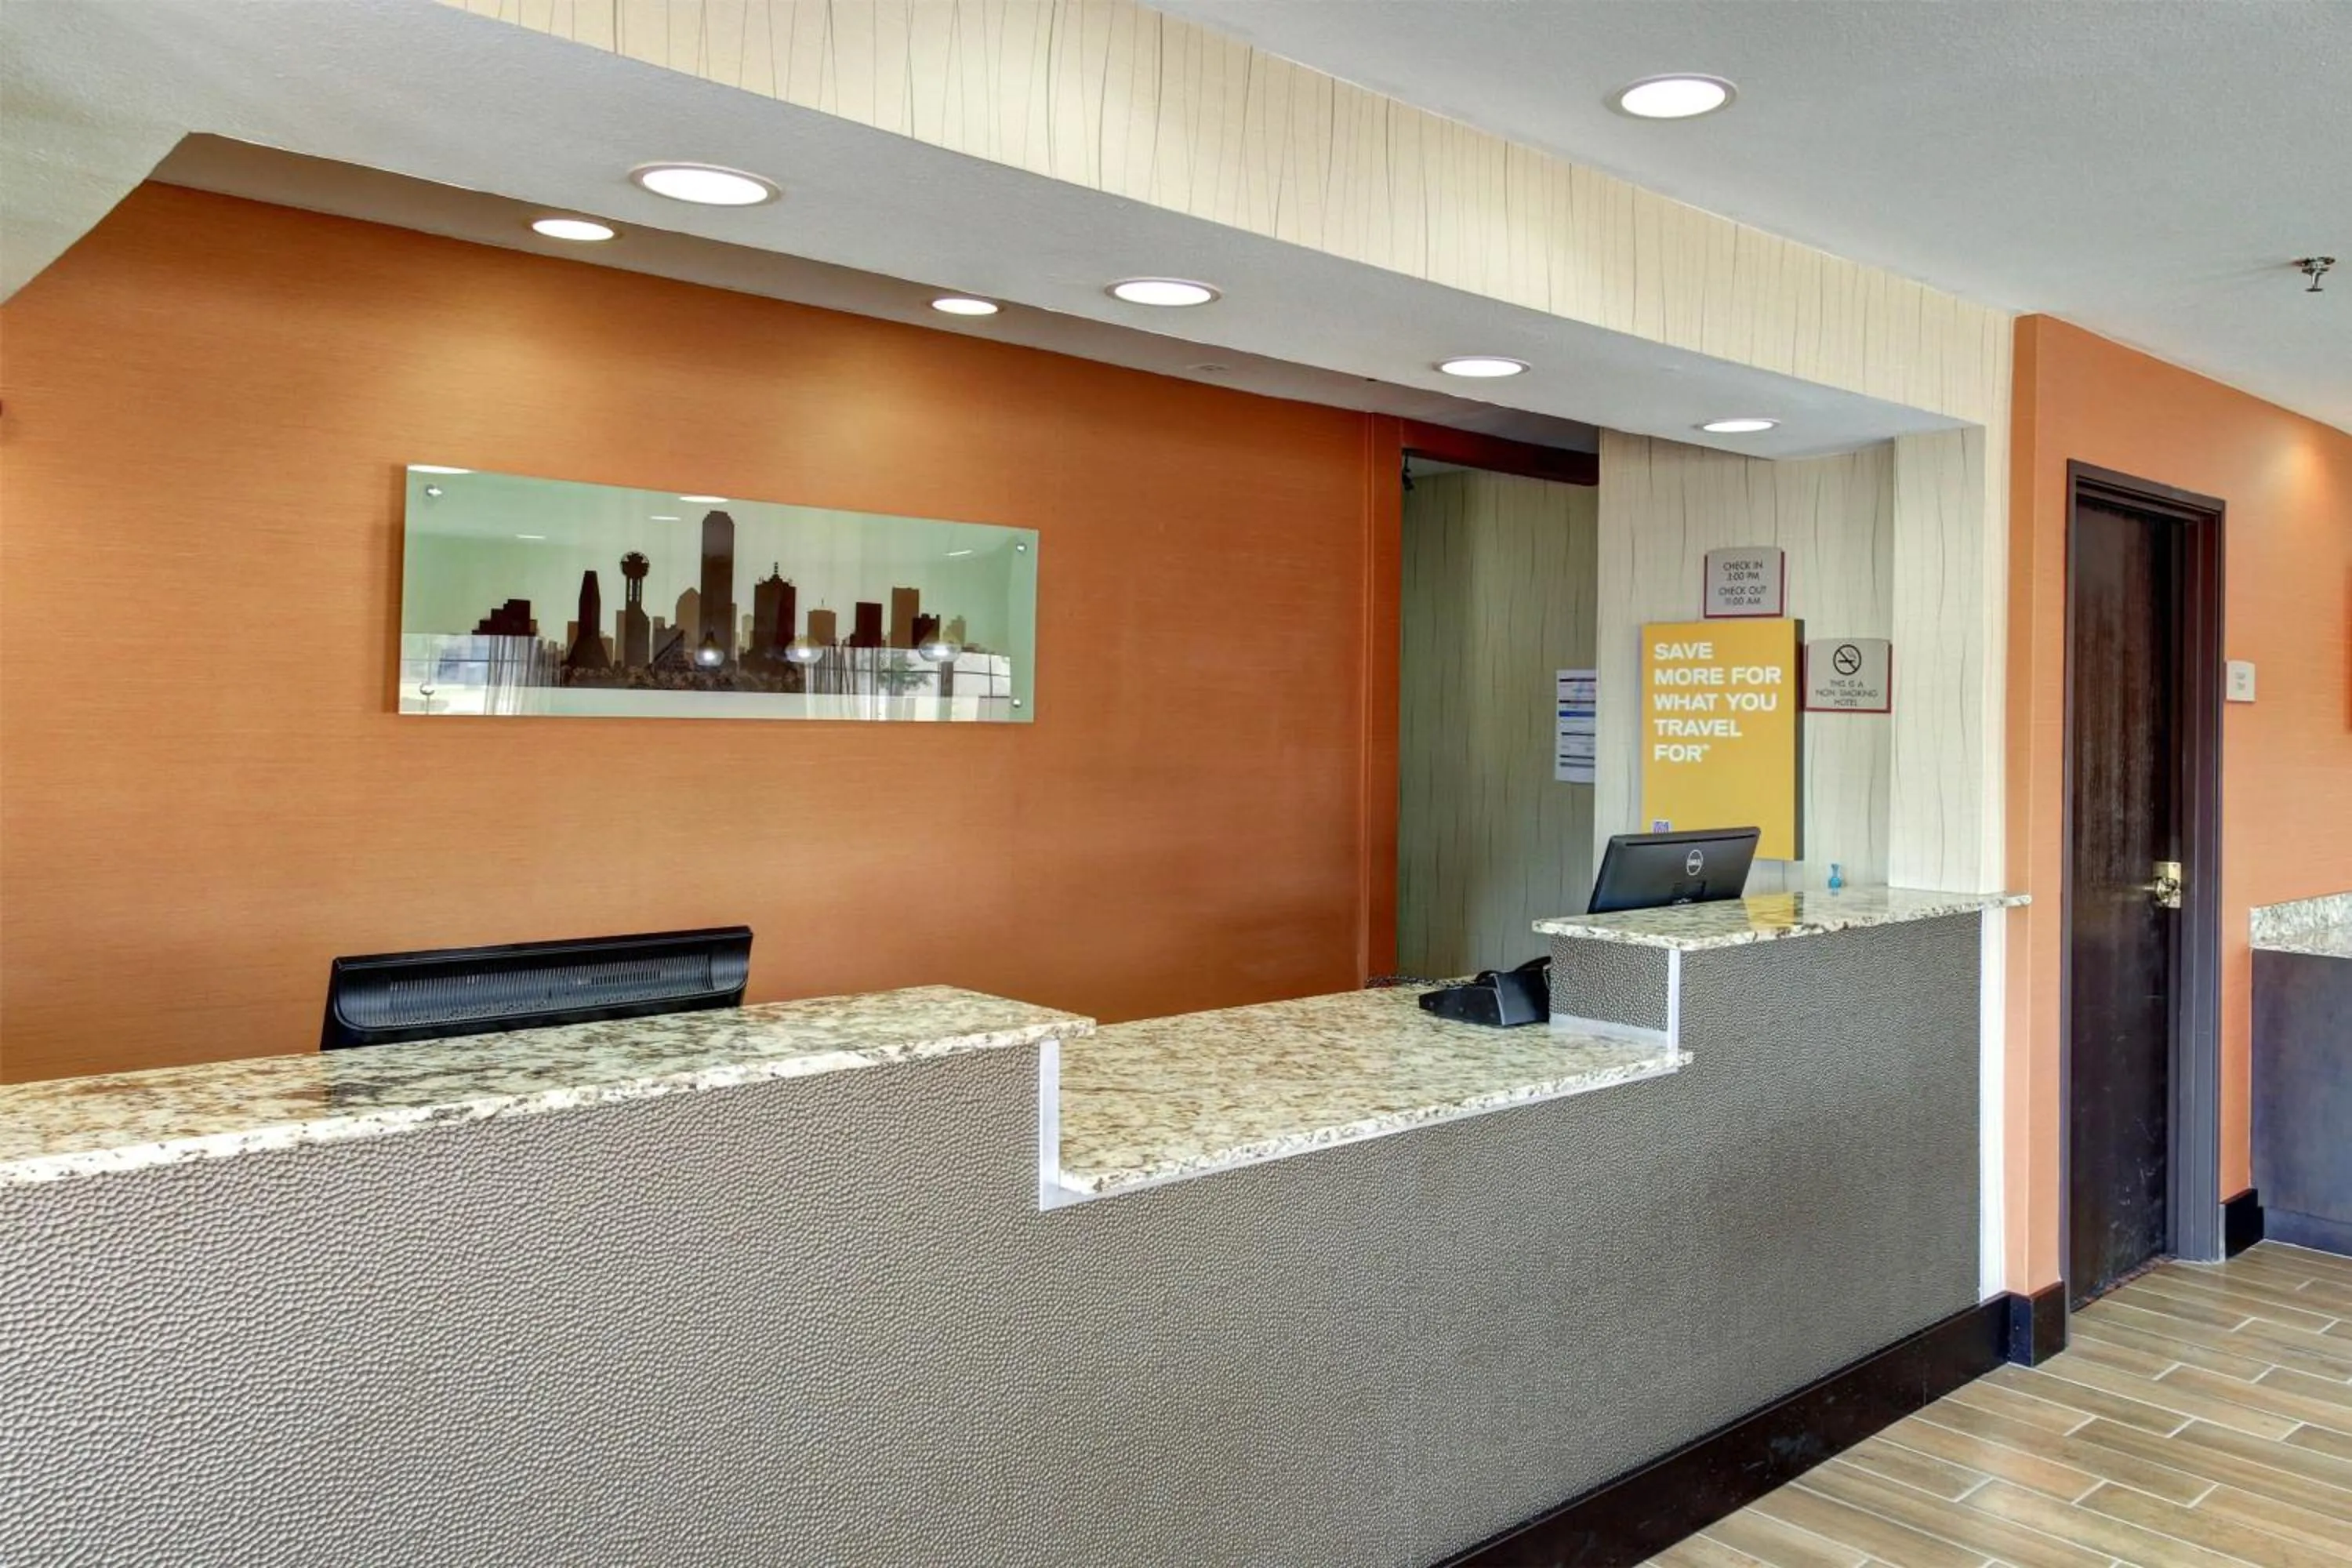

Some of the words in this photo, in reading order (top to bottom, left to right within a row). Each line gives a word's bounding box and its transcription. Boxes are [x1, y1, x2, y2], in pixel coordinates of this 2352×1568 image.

[1723, 561, 1750, 571] CHECK
[1753, 559, 1763, 568] IN
[1747, 572, 1759, 580] PM
[1719, 586, 1746, 596] CHECK
[1748, 585, 1766, 594] OUT
[1654, 642, 1713, 660] SAVE
[1654, 668, 1725, 685] MORE
[1731, 666, 1782, 684] FOR
[1653, 693, 1719, 711] WHAT
[1725, 692, 1777, 711] YOU
[1653, 719, 1743, 737] TRAVEL
